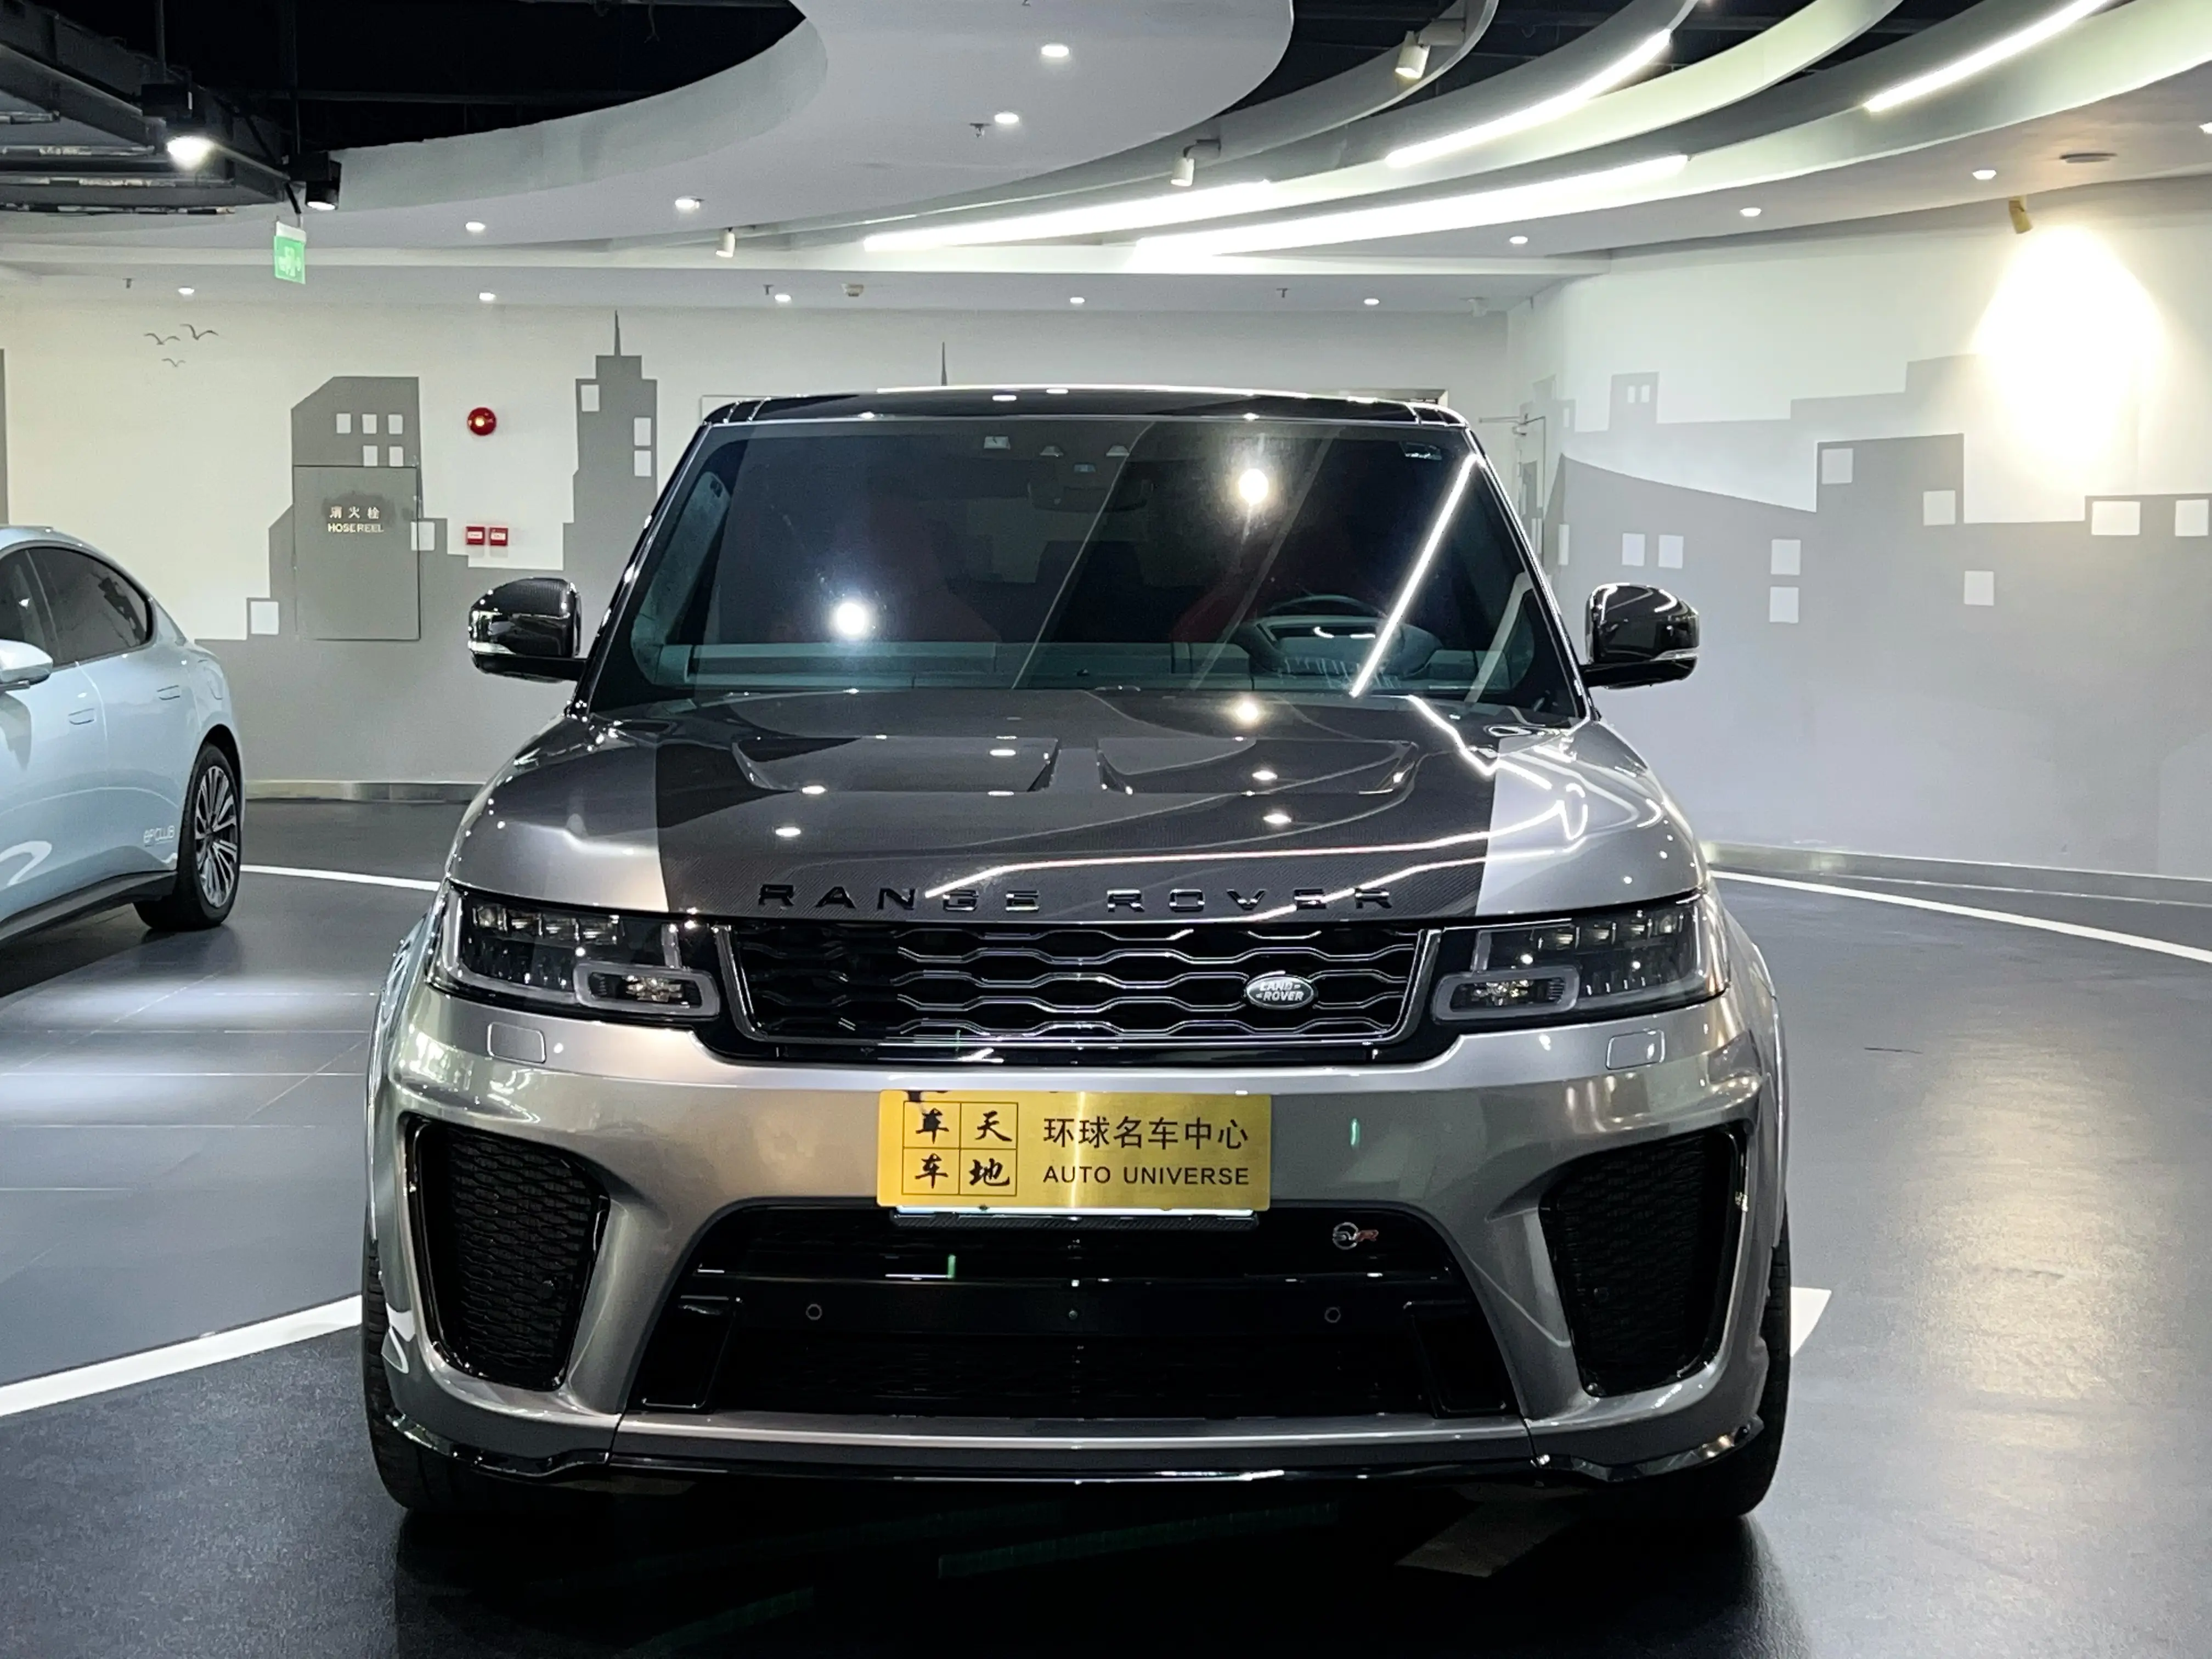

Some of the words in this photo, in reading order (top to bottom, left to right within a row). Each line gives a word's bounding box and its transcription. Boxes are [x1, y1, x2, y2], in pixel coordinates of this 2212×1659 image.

[328, 523, 356, 533] HOSE
[357, 523, 384, 533] REEL
[758, 884, 1039, 912] RANGE
[1106, 887, 1392, 912] ROVER
[1260, 981, 1294, 991] LAND
[1263, 991, 1305, 1001] ROVER
[1043, 1115, 1249, 1150] 环球名车中心
[1043, 1165, 1111, 1184] AUTO
[1123, 1166, 1249, 1186] UNIVERSE
